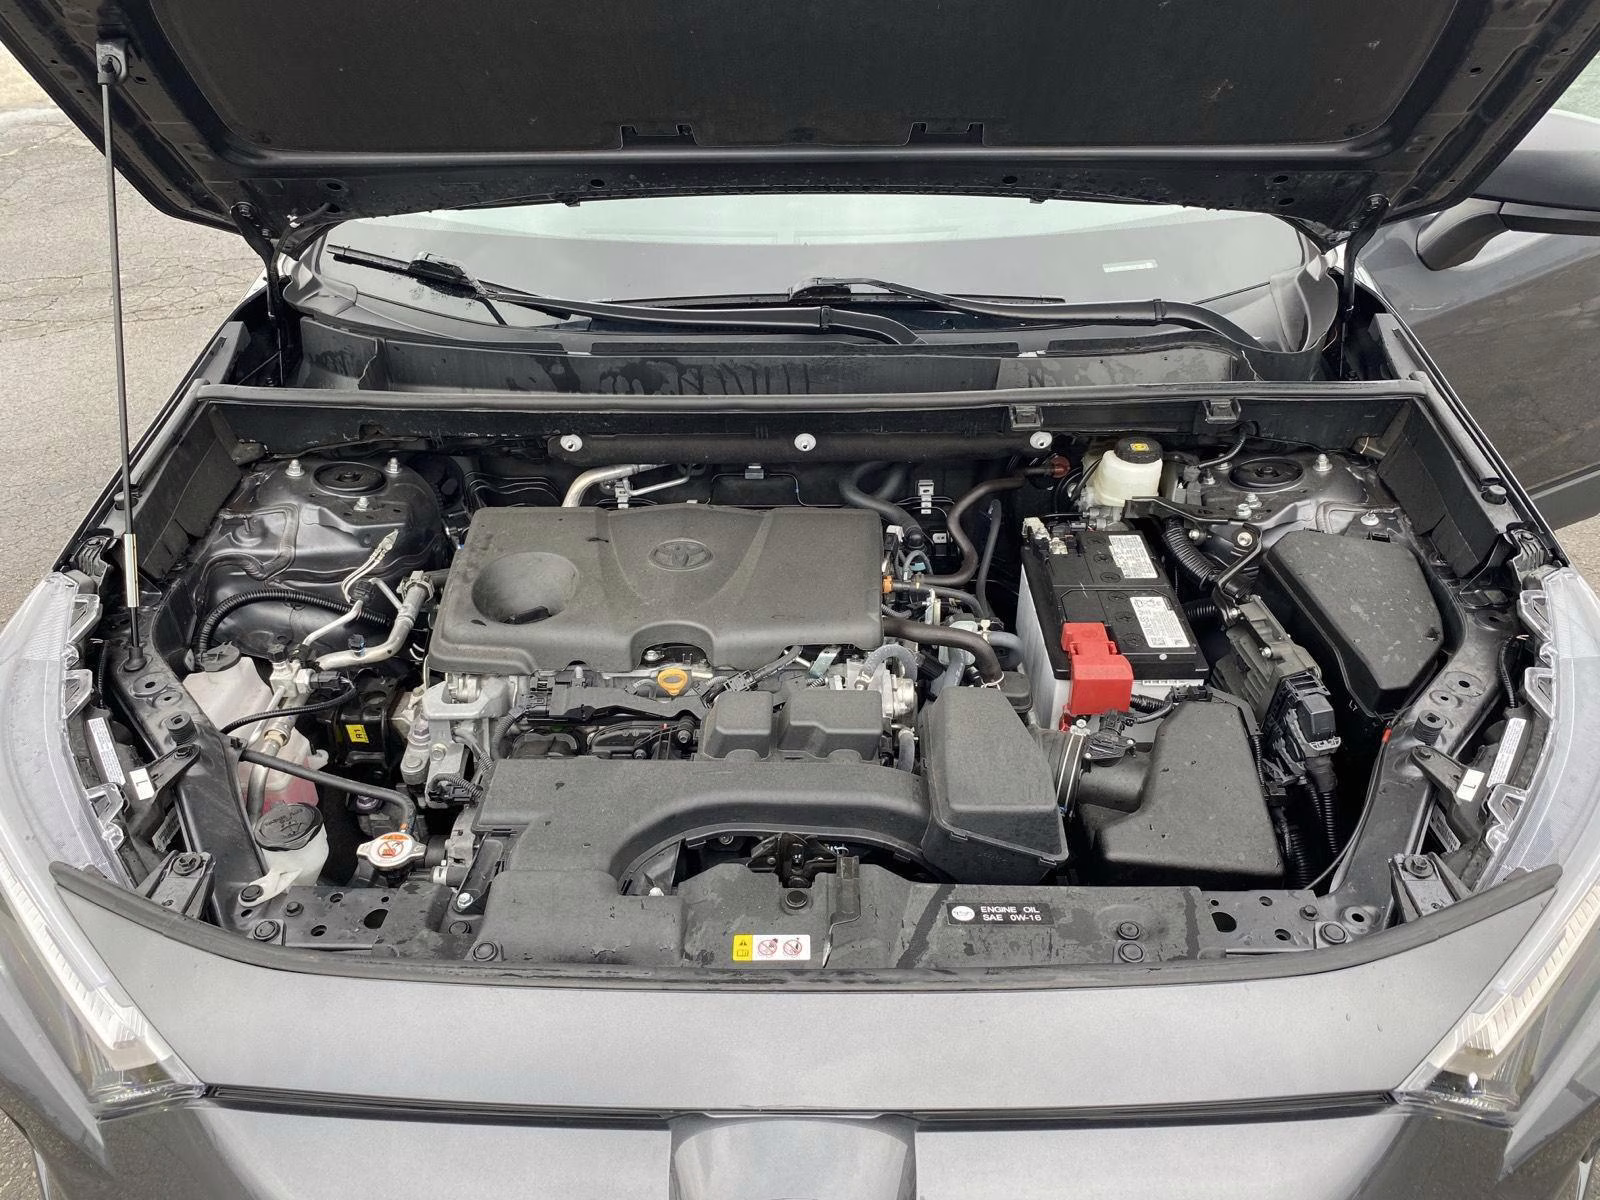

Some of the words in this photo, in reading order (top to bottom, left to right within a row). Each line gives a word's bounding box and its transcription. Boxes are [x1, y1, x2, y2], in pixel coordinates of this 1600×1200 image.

[353, 729, 364, 739] R1
[980, 906, 1017, 914] ENGINE
[1022, 906, 1040, 914] OIL
[982, 914, 1004, 922] SAE
[1009, 914, 1042, 922] 0W-16
